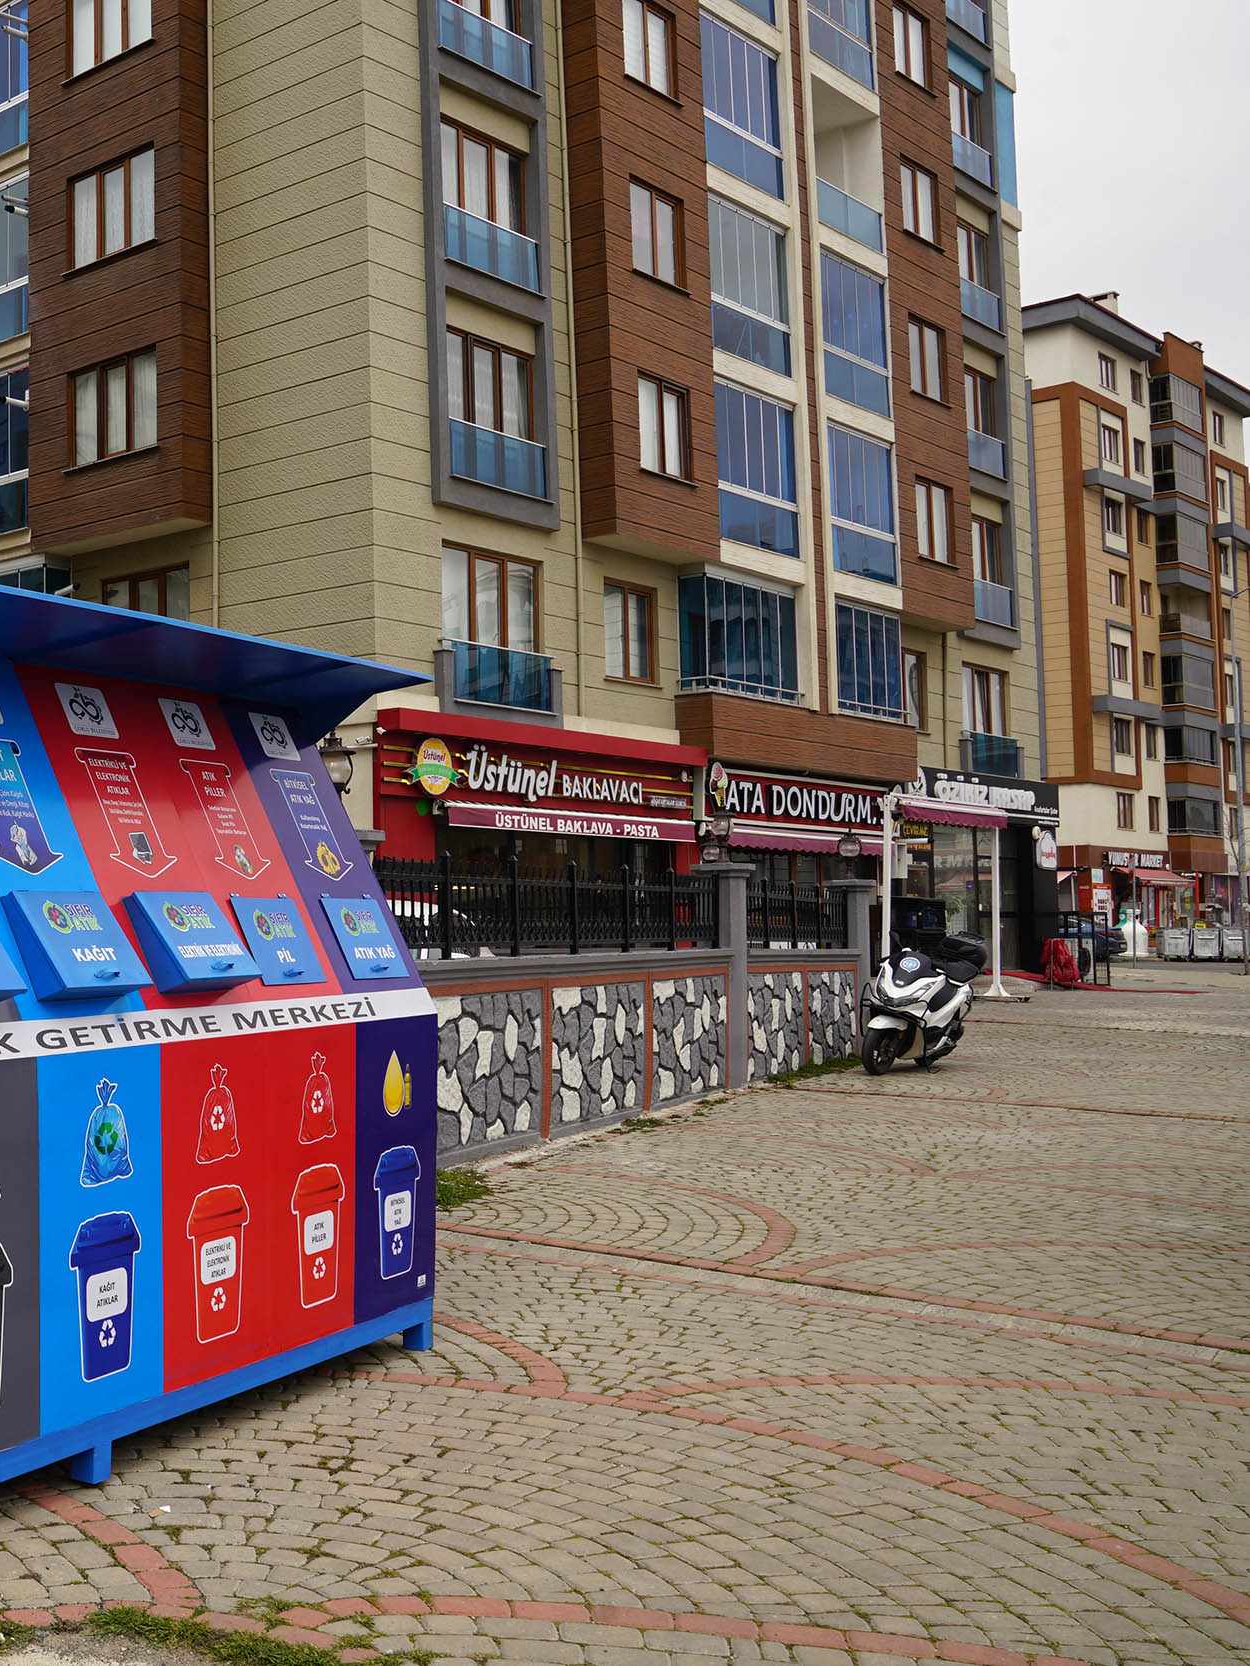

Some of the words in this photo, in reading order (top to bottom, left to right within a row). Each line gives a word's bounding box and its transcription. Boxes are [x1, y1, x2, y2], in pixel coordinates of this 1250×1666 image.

[466, 744, 557, 802] Üstünel
[562, 775, 643, 805] BAKLAVACI
[725, 780, 765, 814] ATA
[495, 811, 554, 832] ÜSTÜNEL
[557, 818, 613, 836] BAKLAVA
[623, 823, 660, 838] PASTA
[64, 904, 94, 916] SIFIR
[72, 945, 117, 962] KAĞIT
[276, 947, 296, 963] PİL
[354, 947, 377, 960] ATIK
[377, 944, 396, 959] YAĞ
[35, 1016, 222, 1050] GETİRME
[231, 996, 377, 1033] MERKEZİ
[99, 1282, 116, 1294] KAĞIT
[96, 1294, 119, 1308] ATIKLAR
